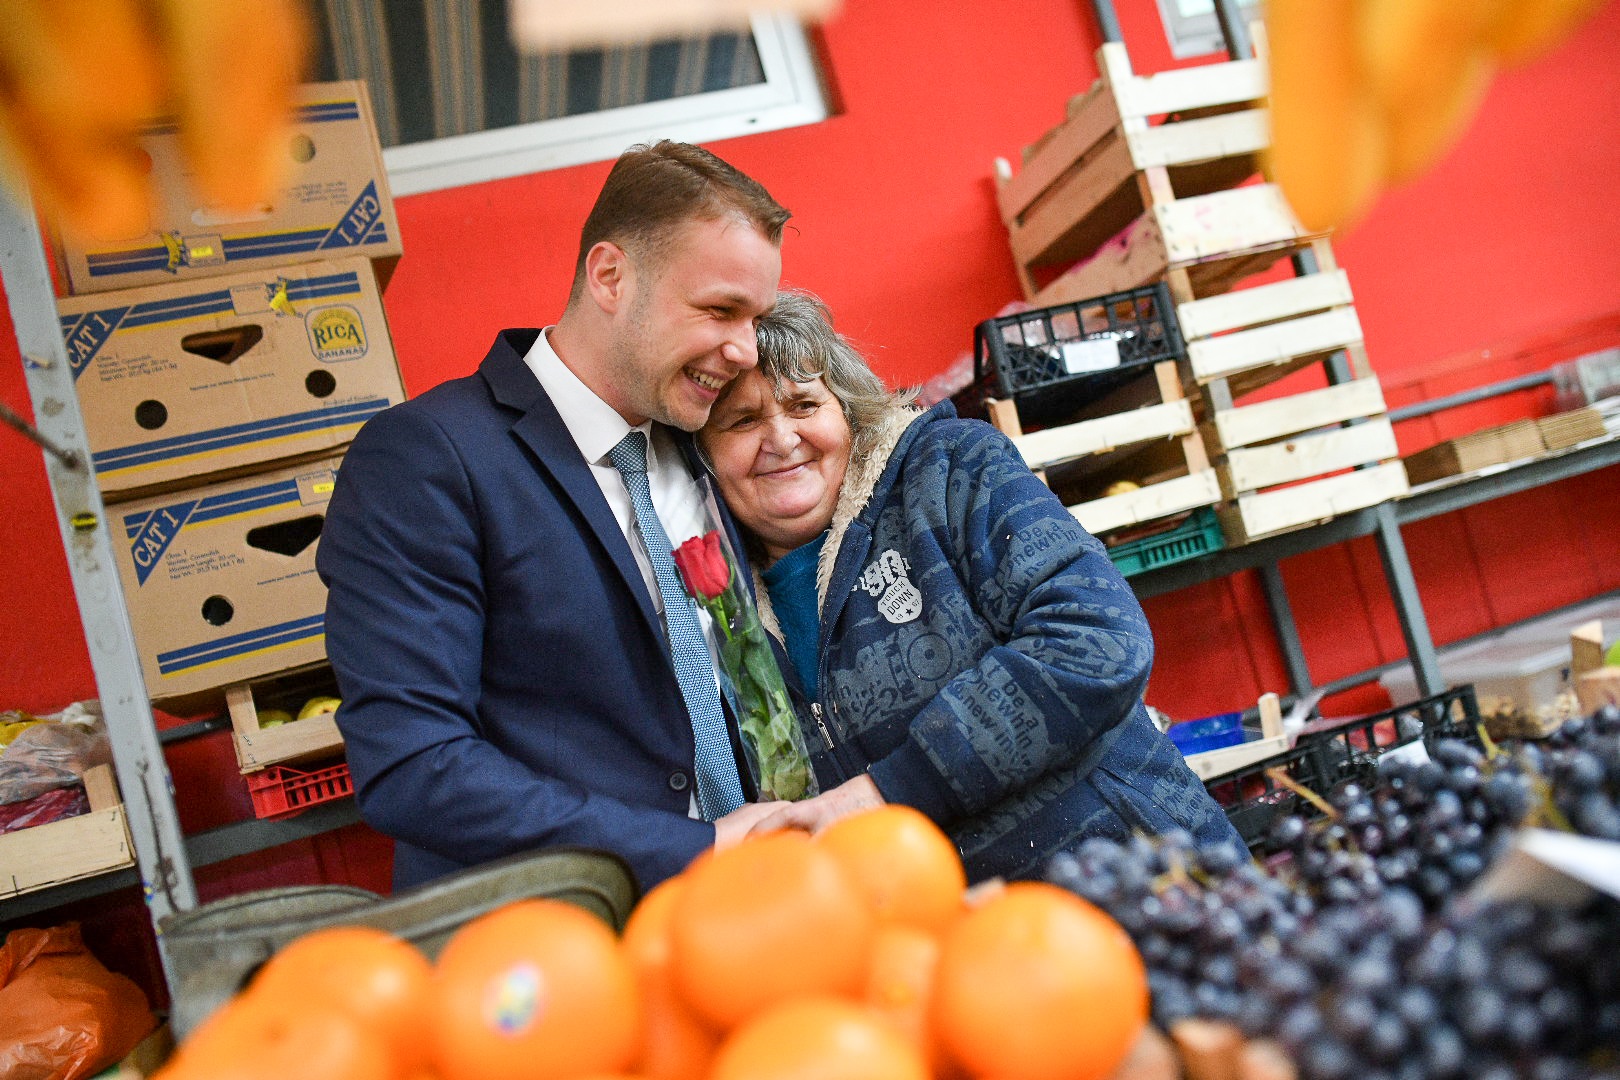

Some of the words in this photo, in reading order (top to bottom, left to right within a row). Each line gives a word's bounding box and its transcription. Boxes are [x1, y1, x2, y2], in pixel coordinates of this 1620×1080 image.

[350, 196, 379, 234] CAT
[67, 325, 98, 368] CAT
[313, 323, 363, 349] RICA
[318, 347, 364, 359] BANANAS
[134, 522, 167, 567] CAT
[880, 580, 906, 606] TOUCH
[886, 588, 914, 616] DOWN
[1002, 681, 1025, 708] be
[963, 695, 998, 730] new
